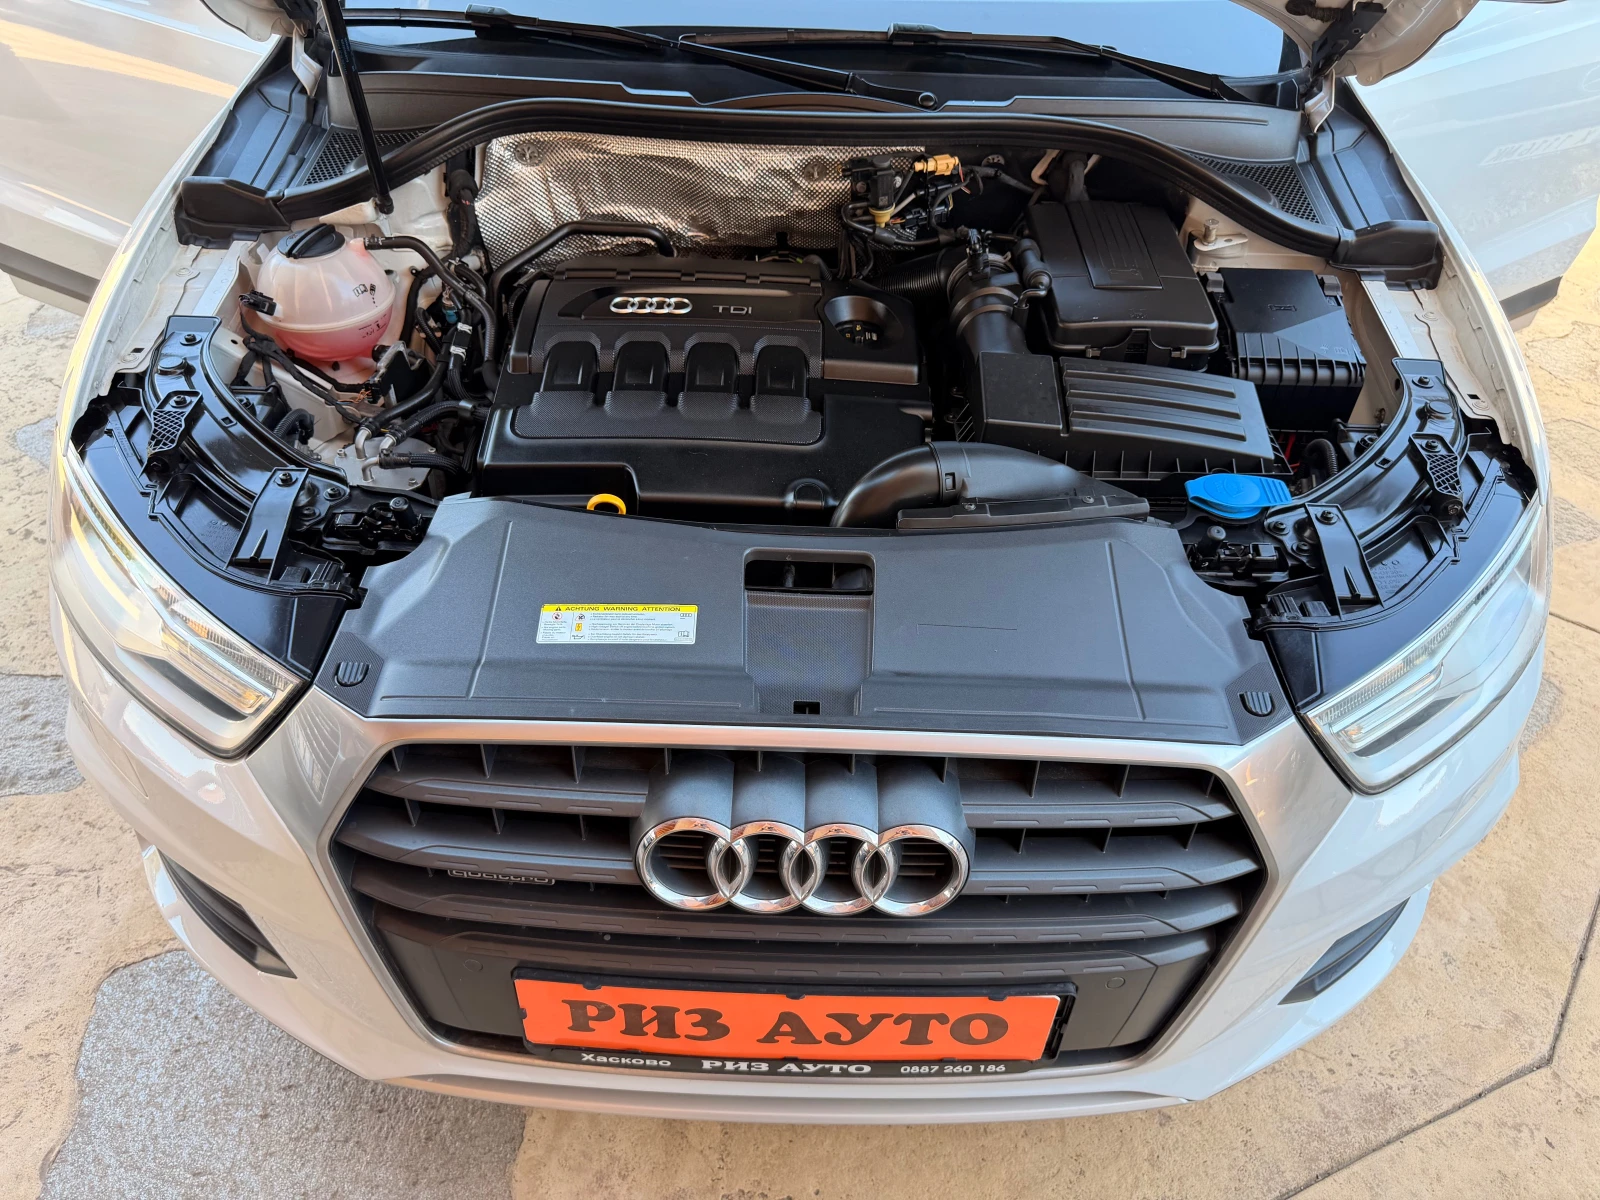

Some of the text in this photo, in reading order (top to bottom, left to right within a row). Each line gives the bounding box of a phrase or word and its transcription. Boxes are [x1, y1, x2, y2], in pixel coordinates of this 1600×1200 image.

[713, 305, 753, 315] TDI
[561, 999, 1009, 1046] РИЗ АУТО
[581, 1052, 1006, 1075] Хасково РИЗ АУТО 0887 260 186
